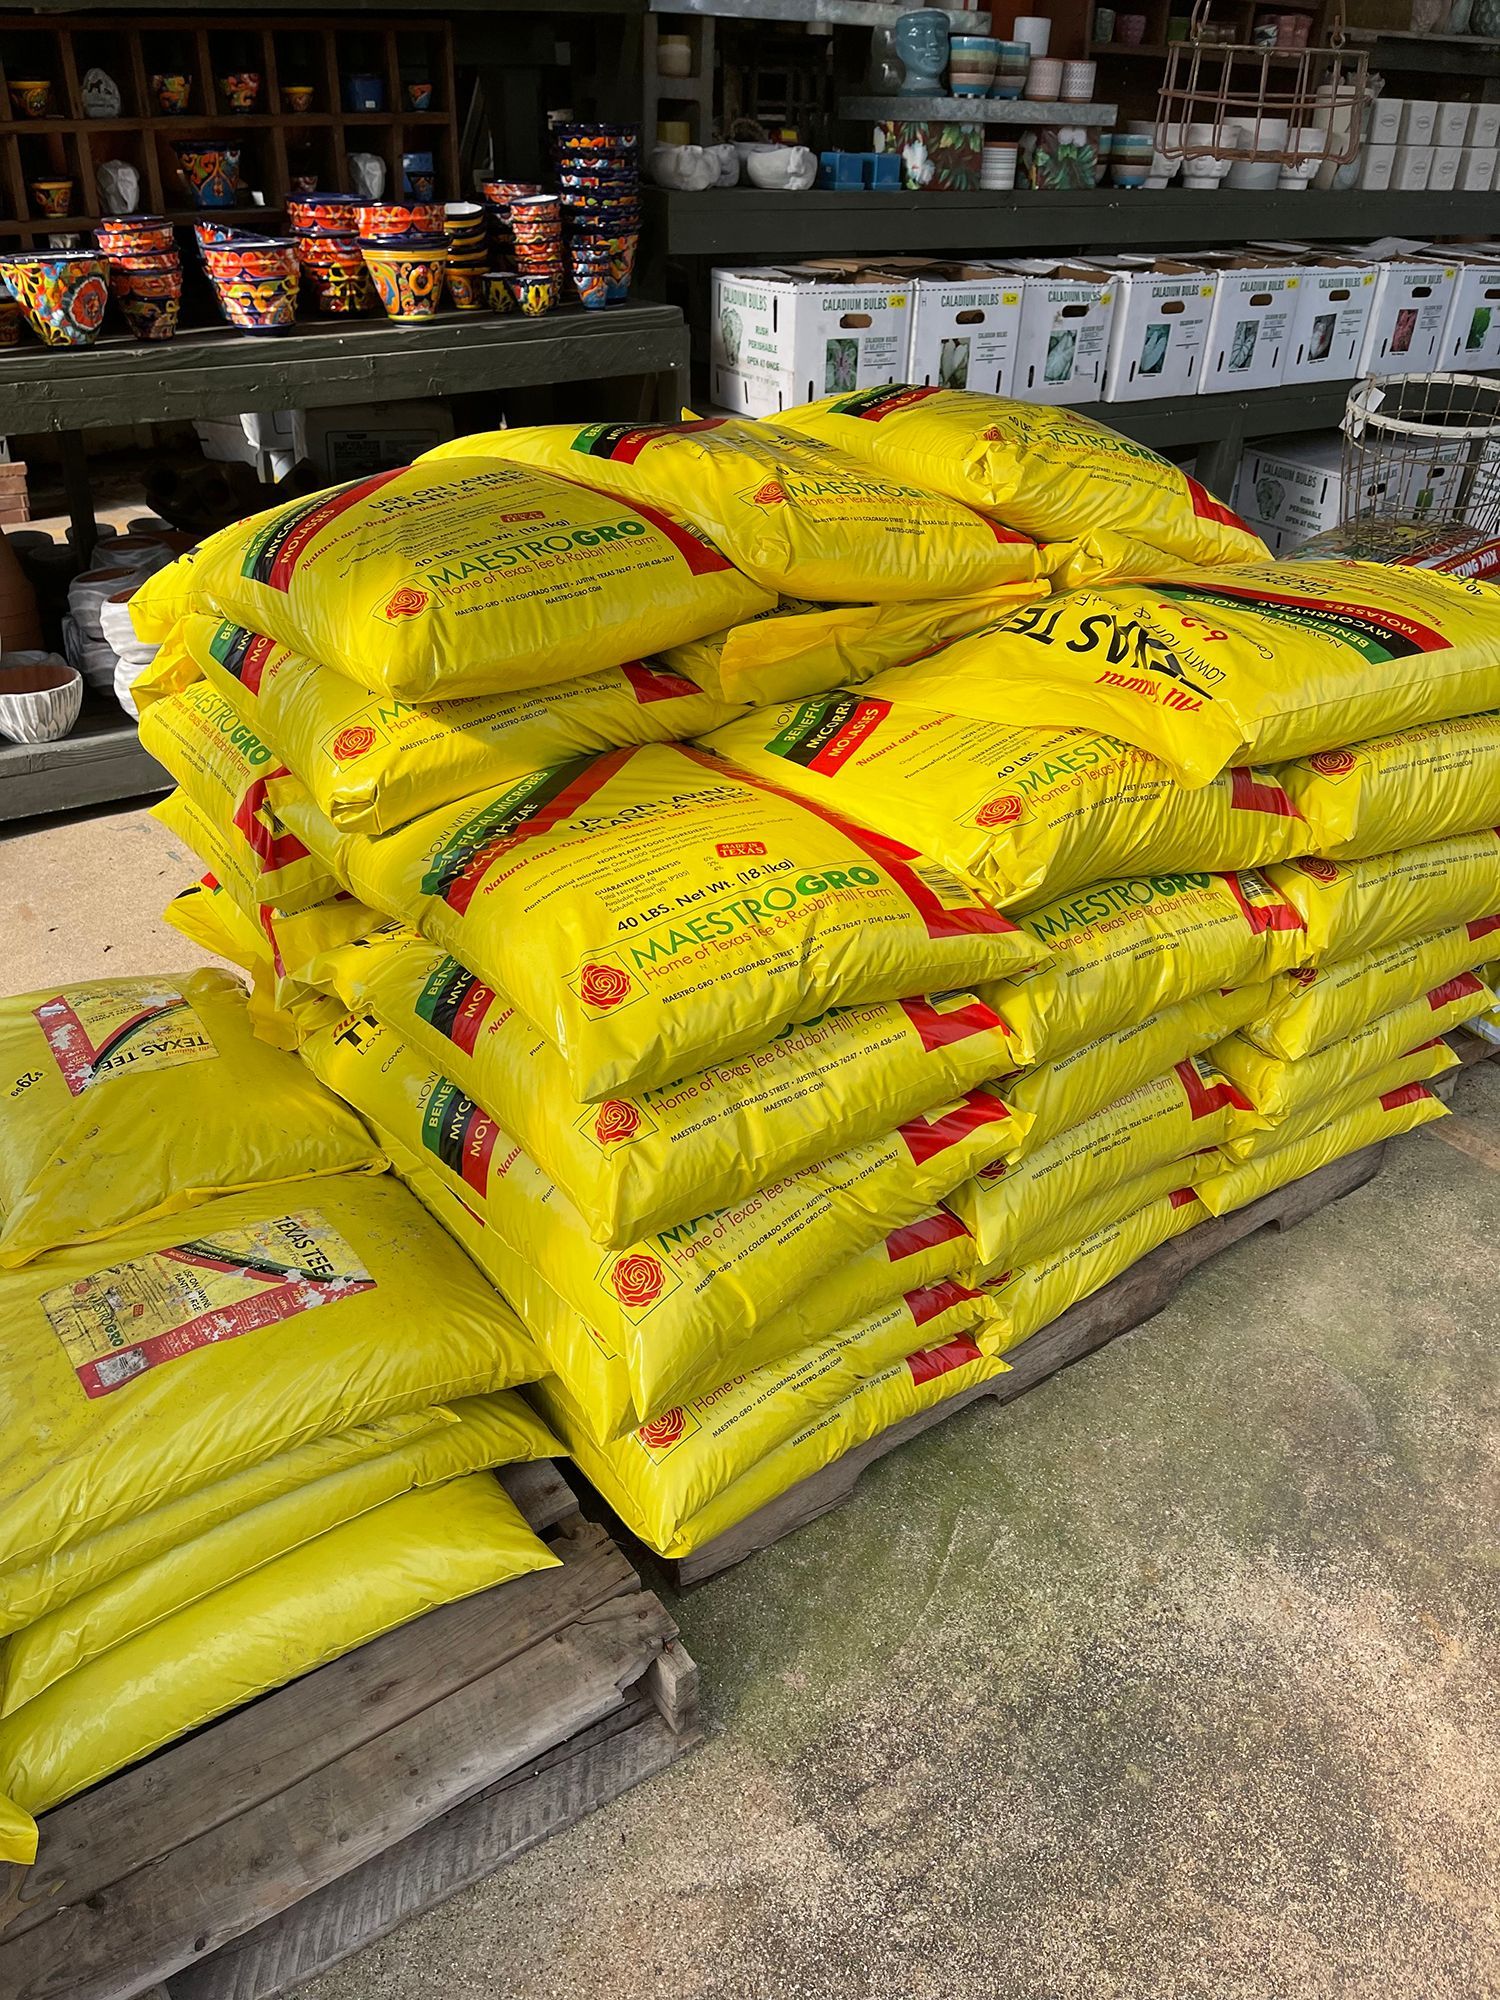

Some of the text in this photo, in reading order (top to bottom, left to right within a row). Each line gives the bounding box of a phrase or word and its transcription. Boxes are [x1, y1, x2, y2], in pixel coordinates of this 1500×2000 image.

[1048, 291, 1081, 303] CALADIUM
[1152, 286, 1180, 298] CALADIUM
[1181, 285, 1199, 296] BULBS
[1240, 281, 1267, 292] CALADIUM
[1268, 280, 1284, 291] BULBS
[1319, 278, 1343, 288] CALADIUM
[1345, 277, 1361, 287] BULBS
[1404, 274, 1443, 285] CALADIUM BULBS
[723, 286, 767, 311] CALADIUM BULBS
[822, 298, 862, 311] CALADIUM
[863, 297, 887, 310] BULBS
[941, 295, 976, 307] CALADIUM
[978, 294, 999, 305] BULBS
[748, 339, 778, 354] PERISHABLE
[755, 326, 769, 336] RUSH
[1263, 462, 1317, 488] CALADIUM BULBS
[1285, 515, 1321, 532] OPEN AT ONCE
[1288, 504, 1322, 520] PERISHABLE
[280, 509, 334, 564] MOLASSES
[426, 520, 646, 588] MAESTROGRO
[439, 534, 658, 597] Home of Texas Tee & Rabbit Hill Farm
[1479, 549, 1498, 569] MIX
[544, 585, 602, 606] MAESTRO-GRO.COM
[1465, 583, 1483, 597] 40
[1182, 592, 1370, 648] BENEFICIAL MICROBES
[1256, 600, 1393, 641] MYCORRHYZAE
[1260, 615, 1344, 650] NOW WITH
[1325, 602, 1418, 636] MOLASSES
[771, 703, 796, 730] NOW
[1161, 685, 1205, 714] All
[185, 684, 272, 766] MAESTROGRO
[387, 700, 448, 735] Home of
[491, 708, 549, 733] MAESTRO-GRO.COM
[828, 708, 879, 758] MOLASSES
[856, 728, 918, 767] Natural and
[496, 771, 548, 810] MICROBES
[1028, 764, 1114, 807] Home of Texas
[569, 801, 651, 831] USE ON
[585, 810, 672, 833] PLANTS
[692, 791, 754, 805] TREES
[1048, 806, 1085, 829] MAESTRO-GRO
[421, 806, 480, 862] NOW WITH
[719, 846, 764, 857] TEXAS
[595, 861, 681, 896] GUARANTEED ANALYSIS
[616, 858, 795, 932] 40 LBS. Net Wt. (18.1kg)
[629, 866, 881, 969] MAESTROGRO
[1030, 872, 1211, 942] MAESTROGRO
[1048, 890, 1223, 952] Home of Texas Tee Rabbit Hill Farm
[643, 886, 895, 982] Home of Texas Tee & Rabbit Hill Farm
[662, 912, 912, 1004] MAESTRO-GRO 613 COLORADO STREET TEXAS 76247 (214) 436-3617
[1118, 1016, 1158, 1045] MAESTRO-GRO.COM
[100, 1035, 210, 1072] TEXAS TEE
[651, 1003, 888, 1117] Home of Texas Tee & Rabbit Hill Farm
[1053, 1048, 1088, 1073] MAESTRO-GRO
[416, 1070, 439, 1110] NOW
[670, 1030, 907, 1143] MAESTRO-GRO 613 COLORADO STREET TEXAS 76247 (214) 436-3617
[763, 1081, 826, 1113] MAESTRO-GRO.COM
[1136, 1076, 1174, 1099] Hill Farm
[671, 1176, 796, 1268] Home of Texas Tee &
[737, 1165, 875, 1261] 613 COLORADO STREET (214)
[777, 1202, 833, 1246] MAESTRO-GRO.COM
[272, 1215, 335, 1276] TEXAS TEE
[712, 1320, 883, 1438] MAESTRO-GRO 613 COLORADO STREET (214)
[791, 1356, 844, 1393] MAESTRO-GRO.COM
[693, 1378, 734, 1413] Home
[791, 1412, 842, 1448] MAESTRO-GRO.COM
